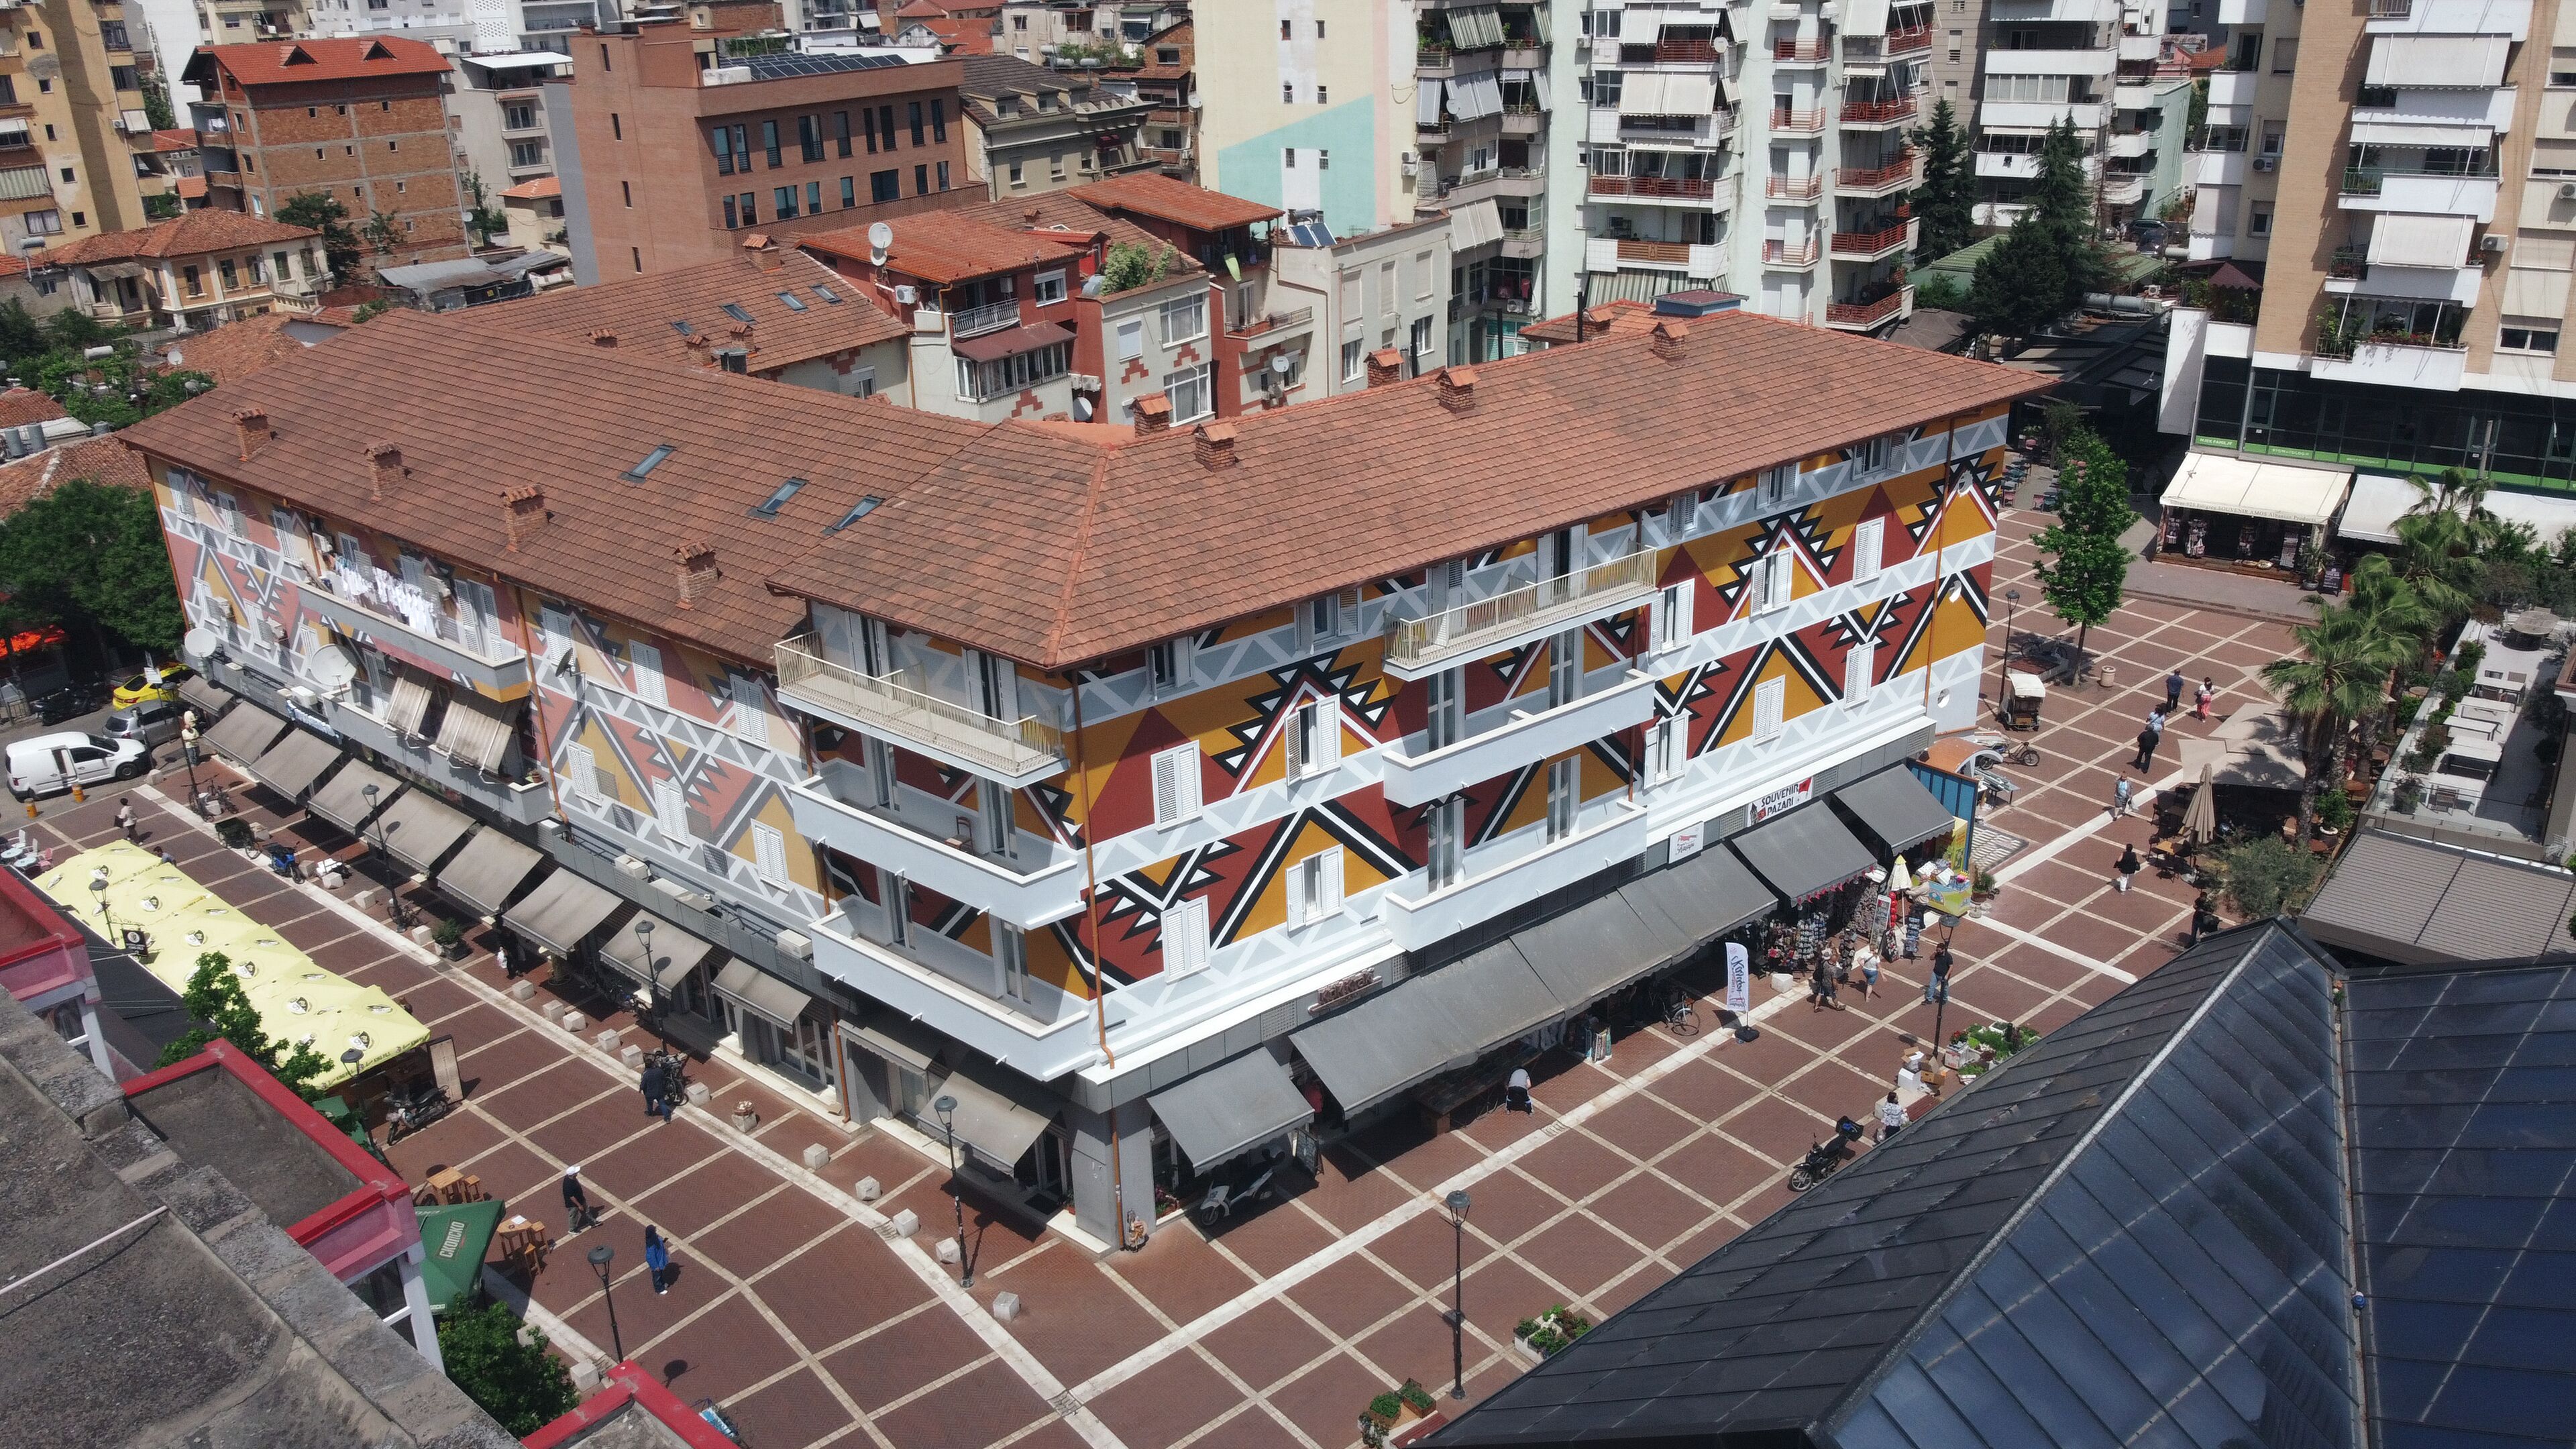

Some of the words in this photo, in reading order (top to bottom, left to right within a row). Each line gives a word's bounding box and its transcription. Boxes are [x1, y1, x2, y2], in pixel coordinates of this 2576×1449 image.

[1761, 784, 1799, 807] SOUVENIR
[1767, 797, 1794, 816] PAZARI
[438, 1221, 465, 1258] СКОПСКО
